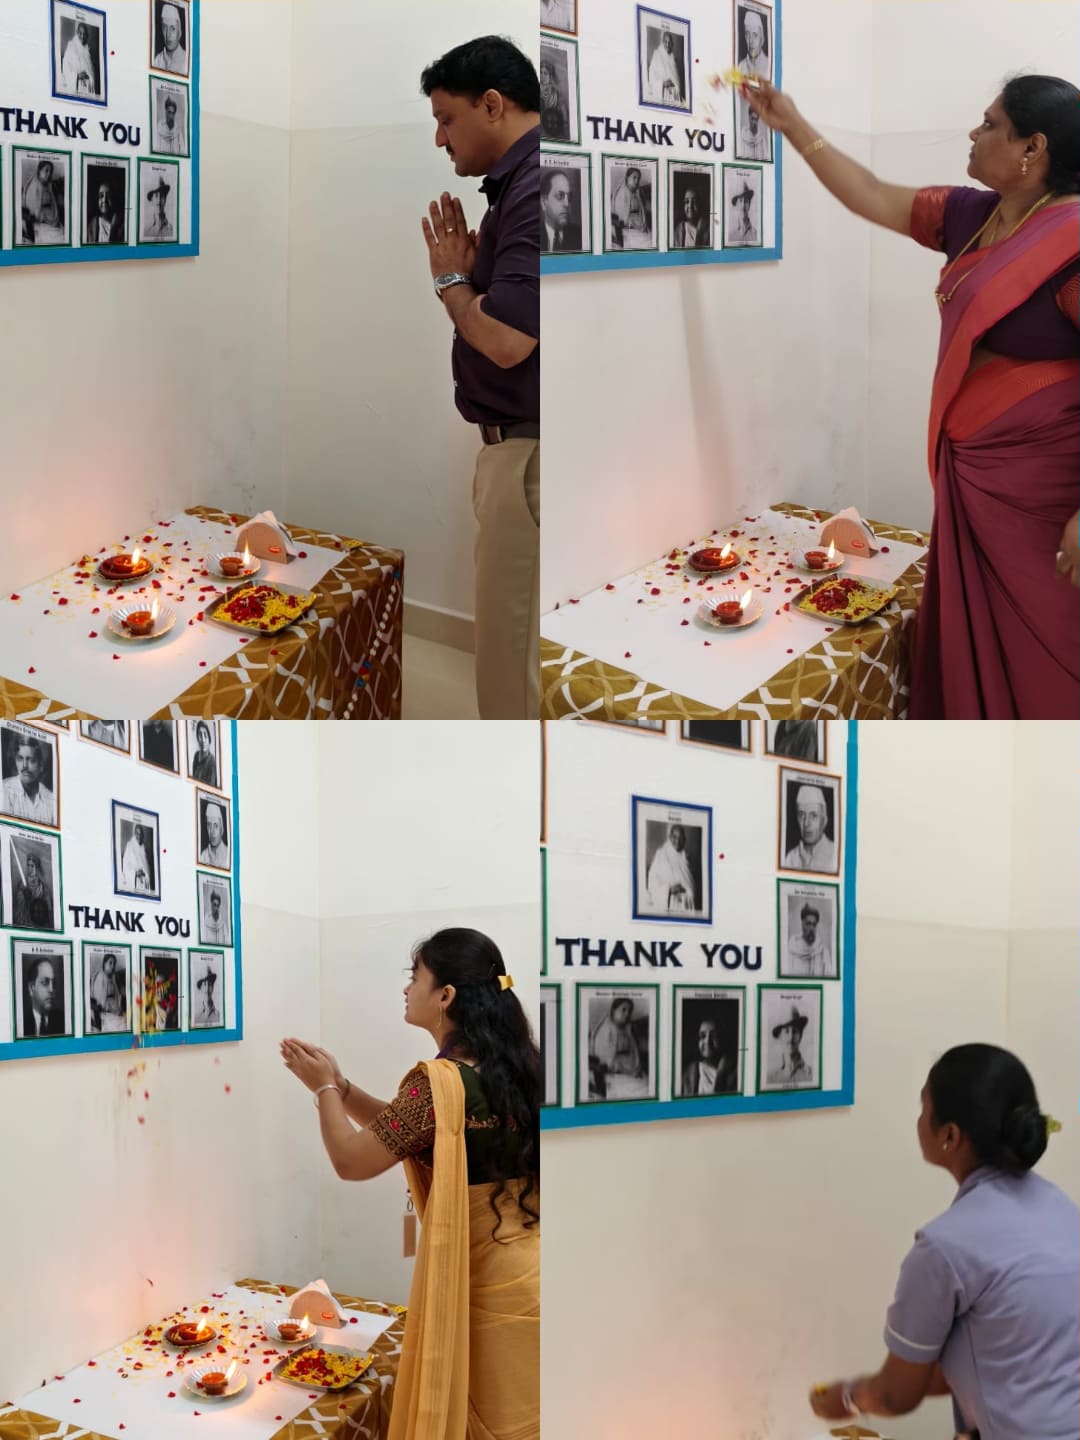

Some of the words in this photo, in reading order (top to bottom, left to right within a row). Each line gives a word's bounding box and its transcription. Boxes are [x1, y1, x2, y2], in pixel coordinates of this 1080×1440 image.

[0, 107, 89, 141] THANK
[99, 120, 141, 147] YOU
[586, 115, 674, 147] THANK
[684, 127, 726, 153] YOU
[68, 904, 146, 934] THANK
[154, 914, 192, 939] YOU
[555, 937, 684, 968] THANK
[700, 943, 764, 971] YOU
